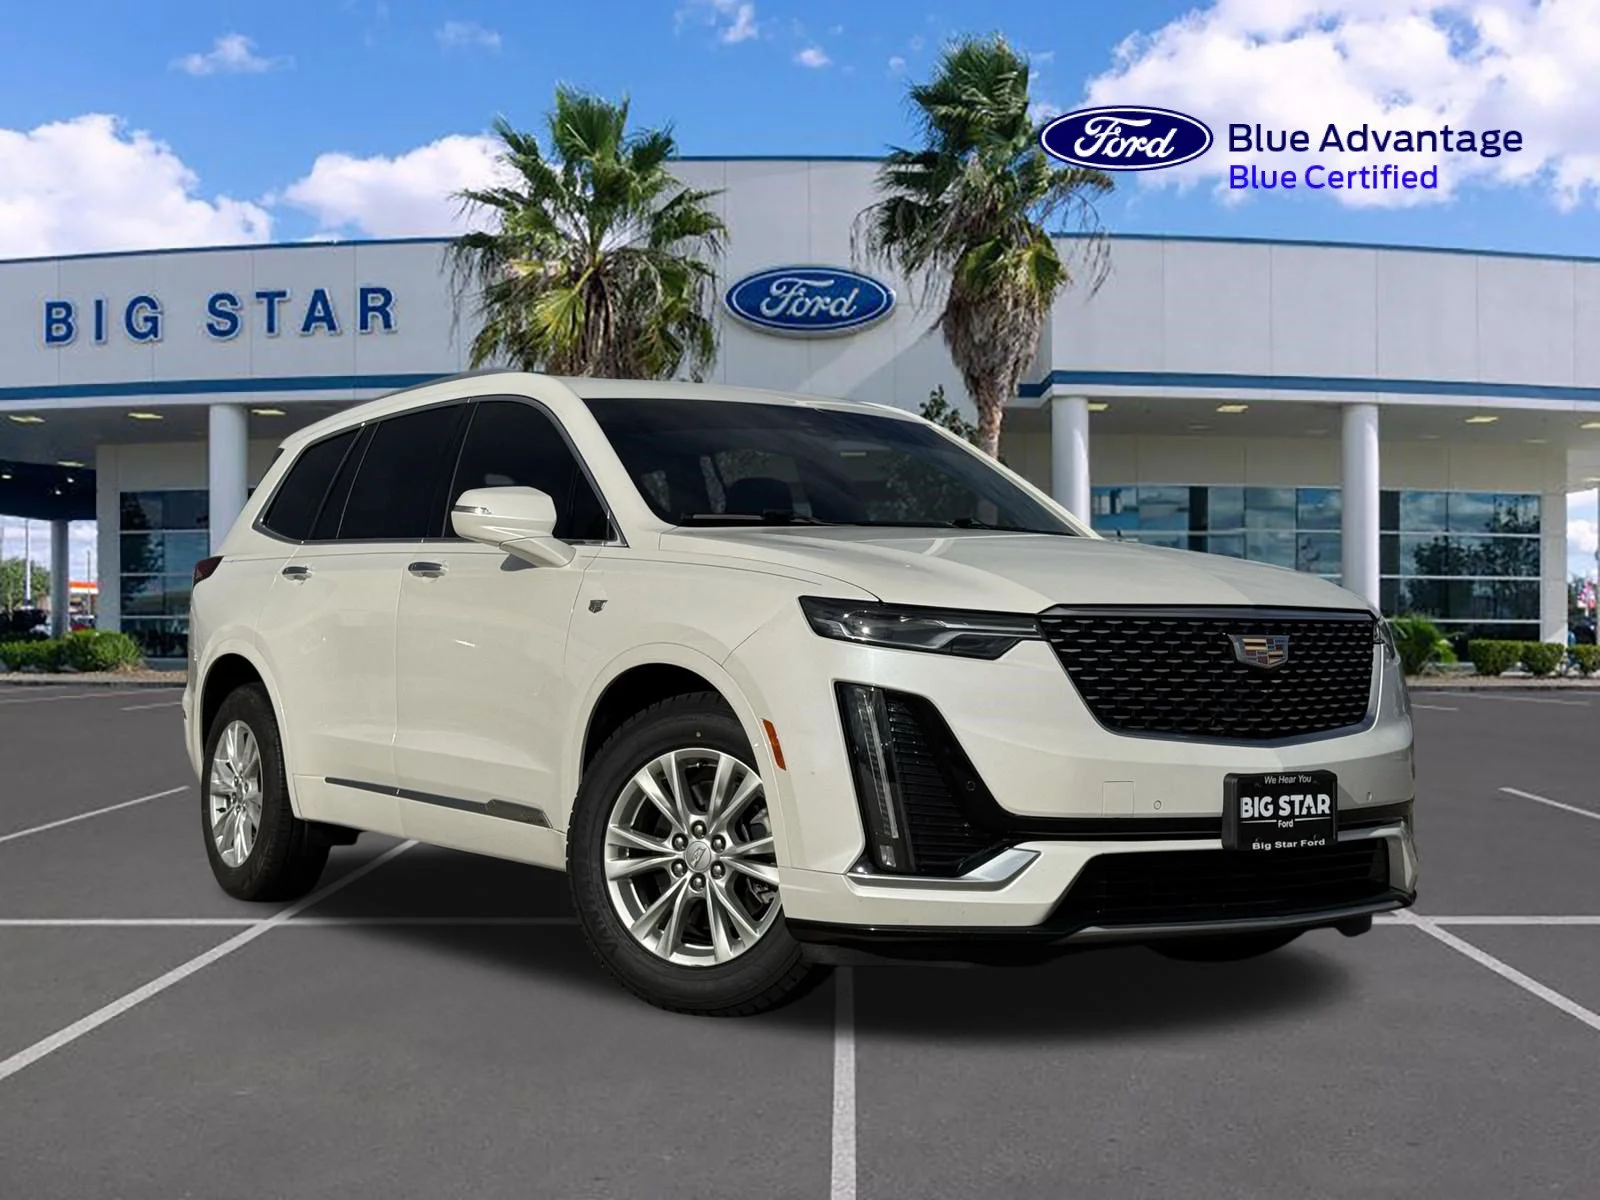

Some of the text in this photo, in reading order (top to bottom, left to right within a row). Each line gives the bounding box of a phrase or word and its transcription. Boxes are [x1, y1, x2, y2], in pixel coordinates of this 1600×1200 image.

[759, 277, 860, 318] Ford
[44, 286, 399, 346] BIG STAR
[1264, 774, 1312, 784] We Hear You
[1240, 794, 1331, 818] BIG STAR
[1278, 820, 1294, 828] Ford
[1252, 838, 1325, 850] Big Star Ford
